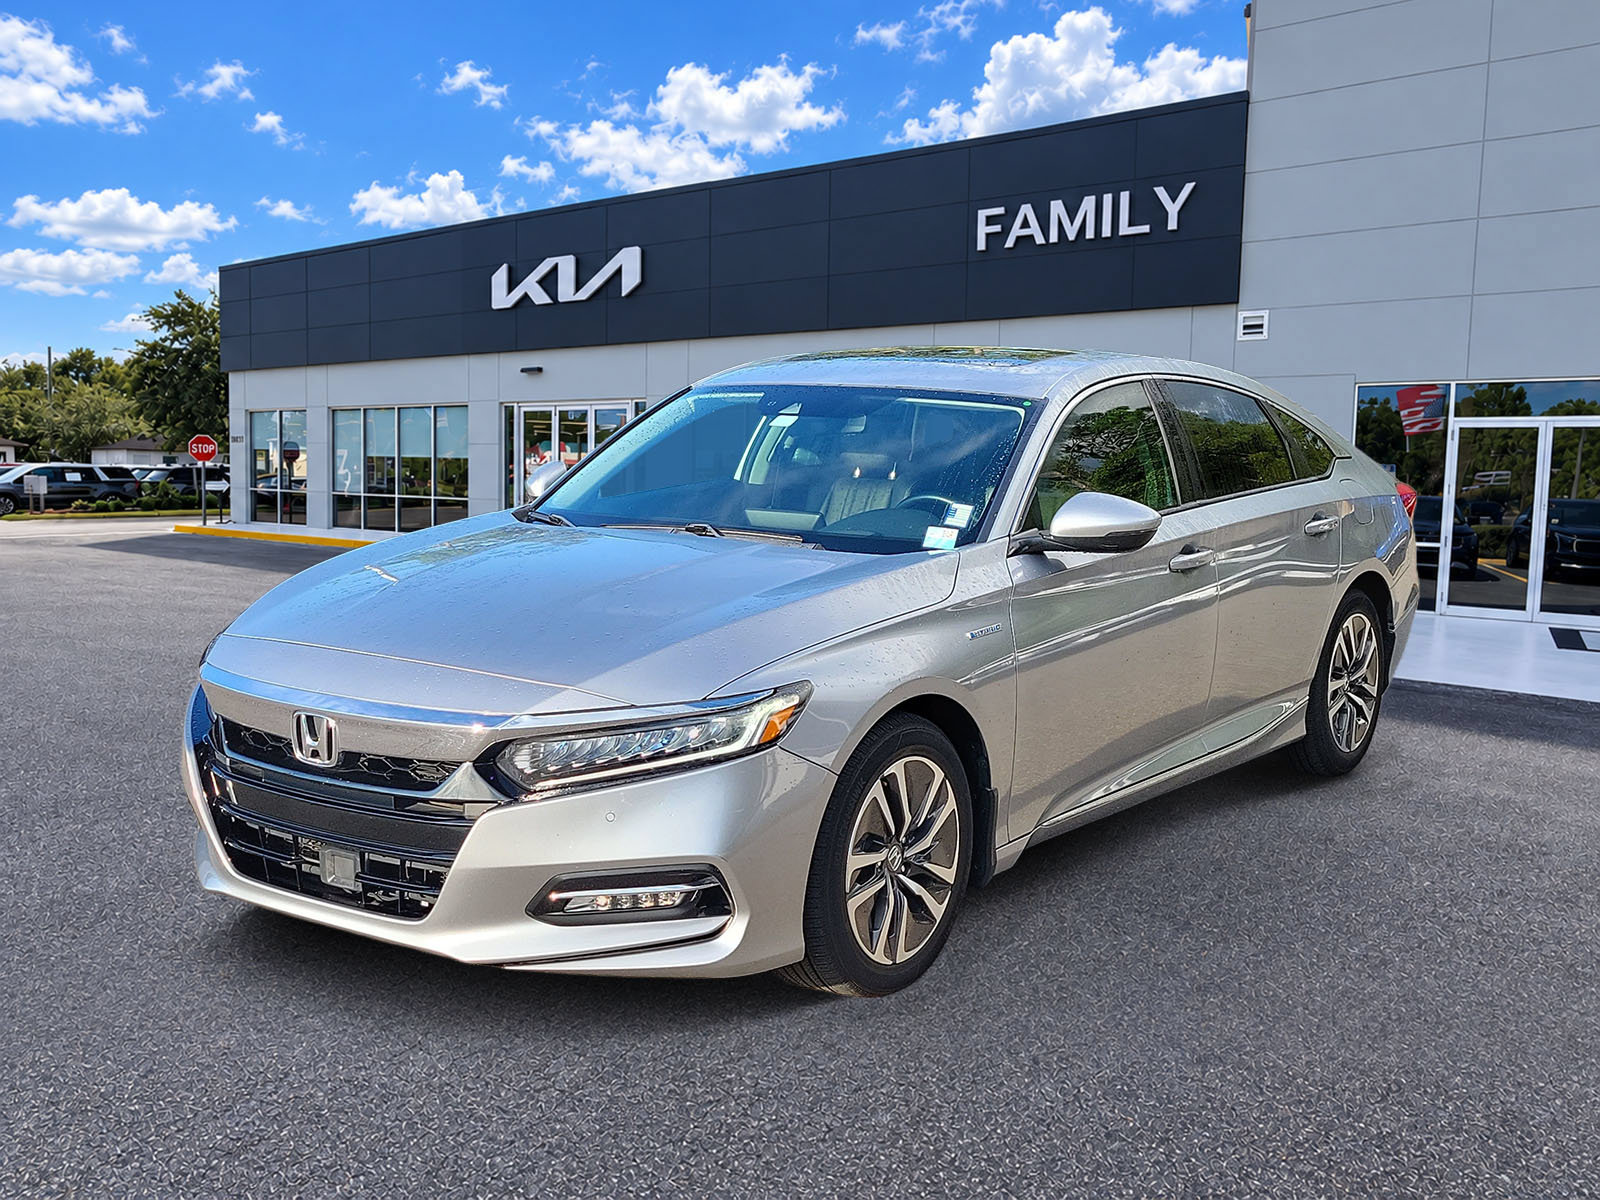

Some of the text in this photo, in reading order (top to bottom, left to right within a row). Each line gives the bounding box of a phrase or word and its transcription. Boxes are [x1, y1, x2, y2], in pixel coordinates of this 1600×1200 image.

[976, 181, 1196, 252] FAMILY
[491, 245, 642, 310] KIA
[191, 443, 215, 454] STOP
